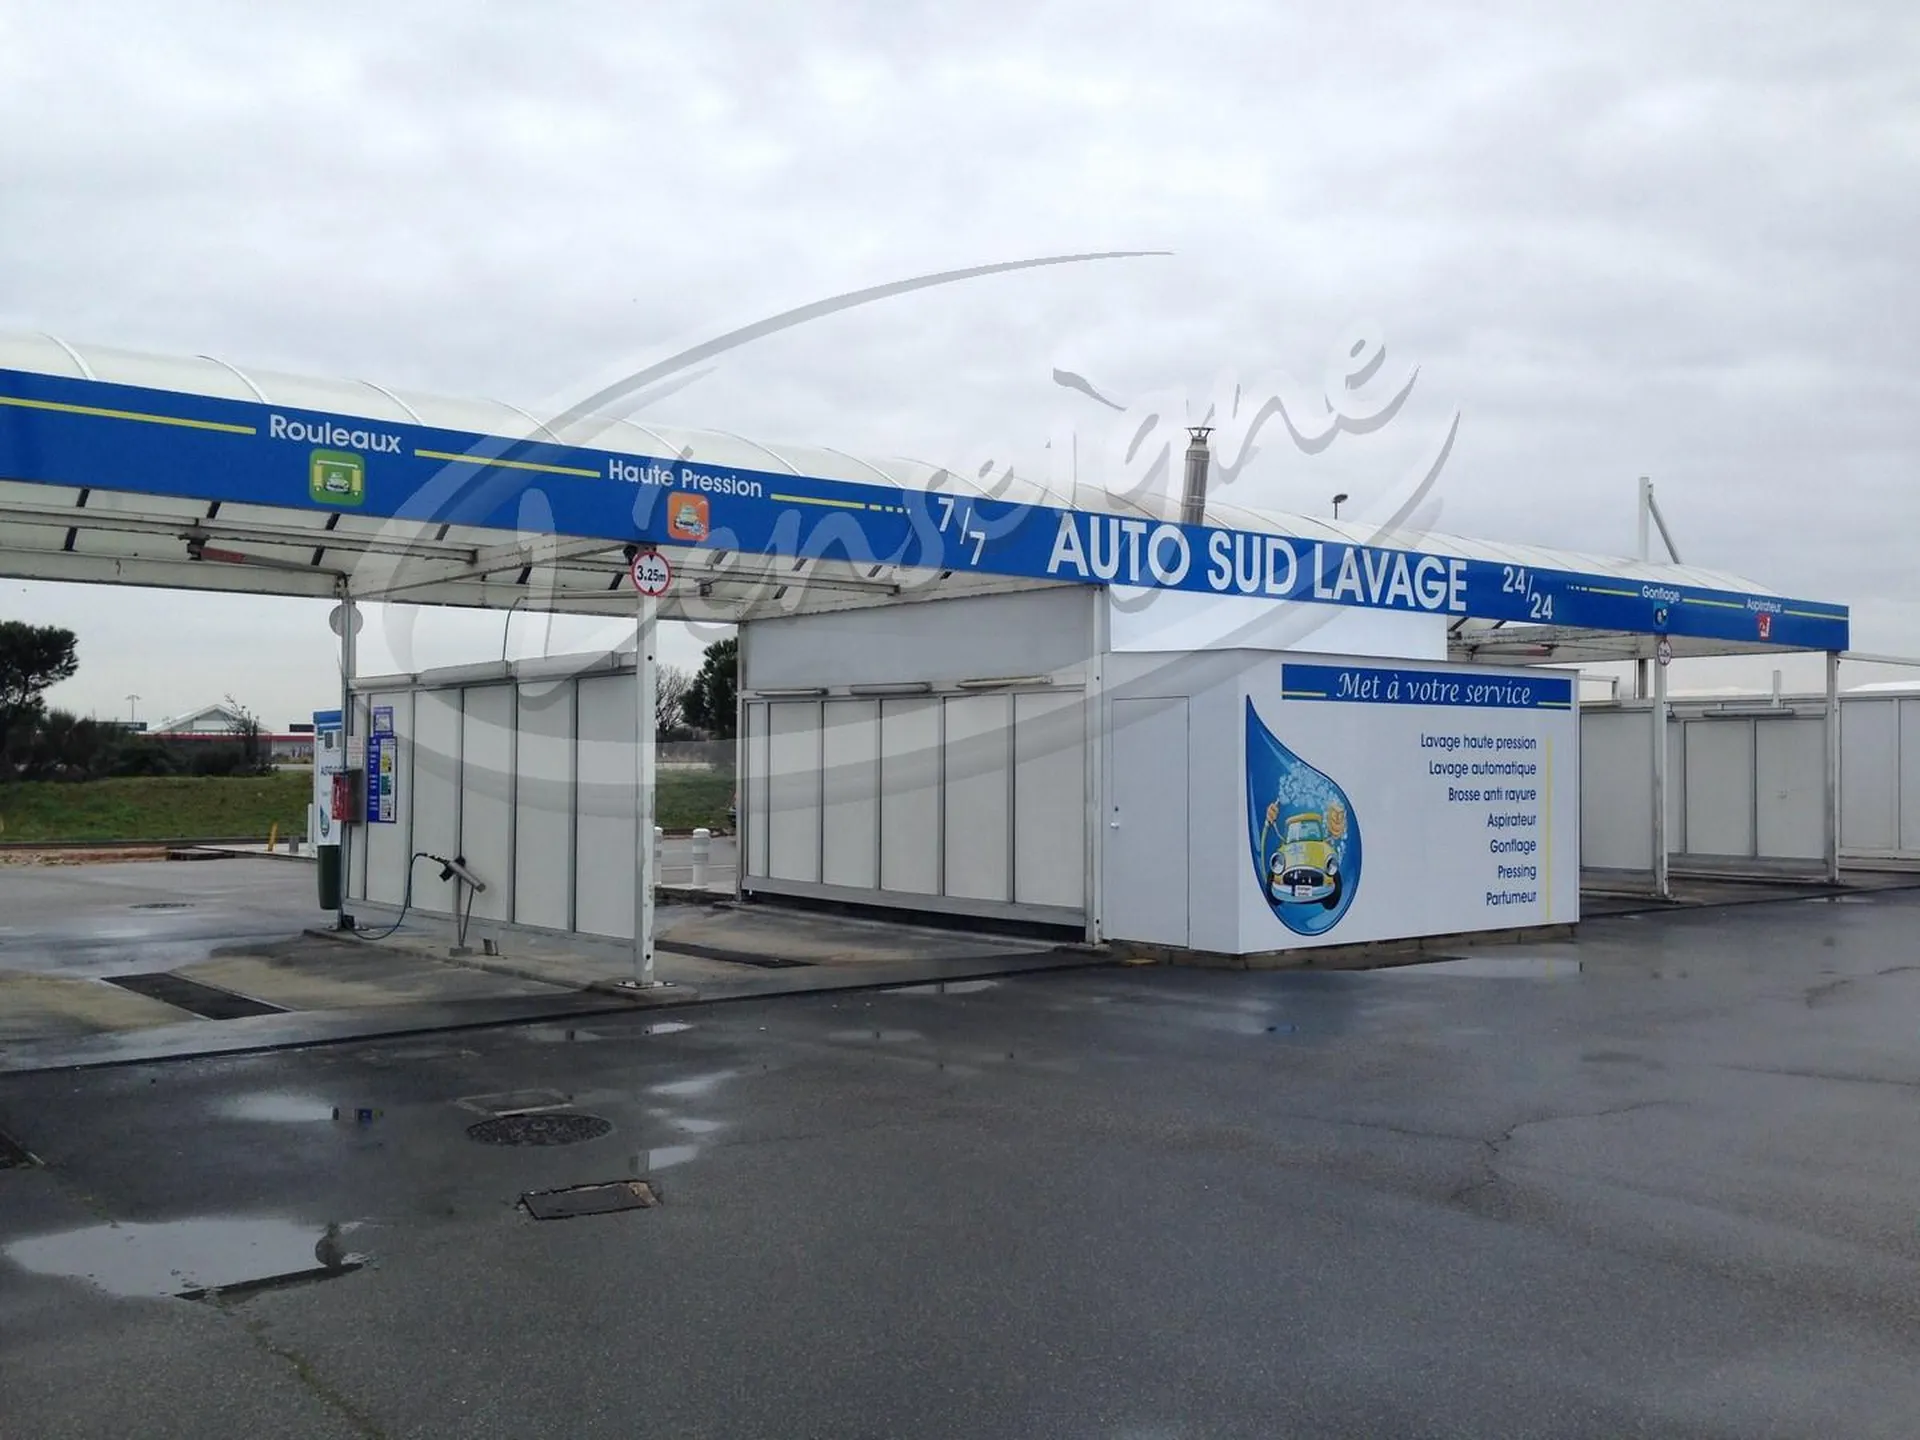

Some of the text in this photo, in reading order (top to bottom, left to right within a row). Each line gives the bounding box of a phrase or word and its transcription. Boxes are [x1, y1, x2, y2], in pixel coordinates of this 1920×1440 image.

[269, 413, 402, 455] Rouleaux
[607, 458, 763, 499] Haute Pression
[1047, 512, 1468, 612] AUTO SUD LAVAGE
[636, 564, 667, 582] 3.25m
[1641, 584, 1681, 604] Gonflage
[1746, 598, 1782, 613] Aspirateur
[1336, 672, 1532, 706] Met à votre service
[1420, 733, 1537, 752] Lavage haute pression
[1429, 760, 1537, 779] Lavage automatique
[1448, 786, 1537, 804] Brosse anti rayure
[1487, 812, 1537, 830] Aspirateur
[1489, 838, 1537, 856] Gonflage
[1498, 864, 1537, 881] Pressing
[1486, 890, 1537, 907] Parfumeur
